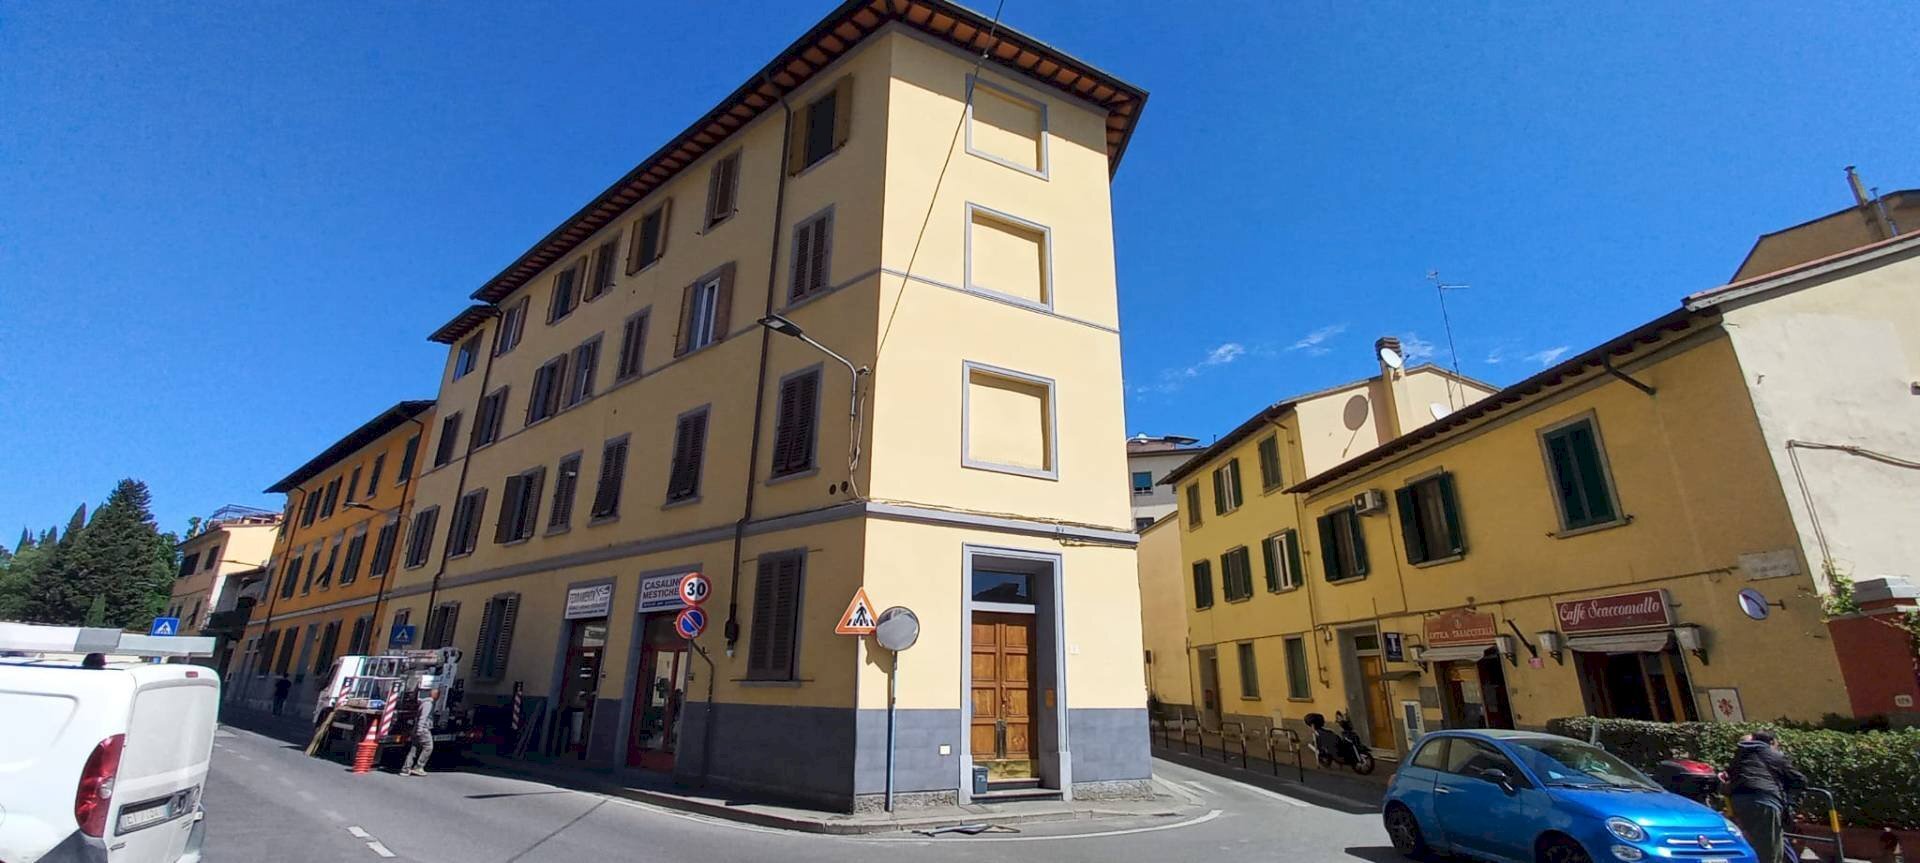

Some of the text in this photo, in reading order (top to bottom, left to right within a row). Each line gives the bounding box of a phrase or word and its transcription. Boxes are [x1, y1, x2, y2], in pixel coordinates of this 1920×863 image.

[644, 577, 680, 590] CASALIN
[687, 582, 706, 596] 30
[642, 588, 679, 600] MESTICHE
[1588, 596, 1660, 619] Scaccomatto
